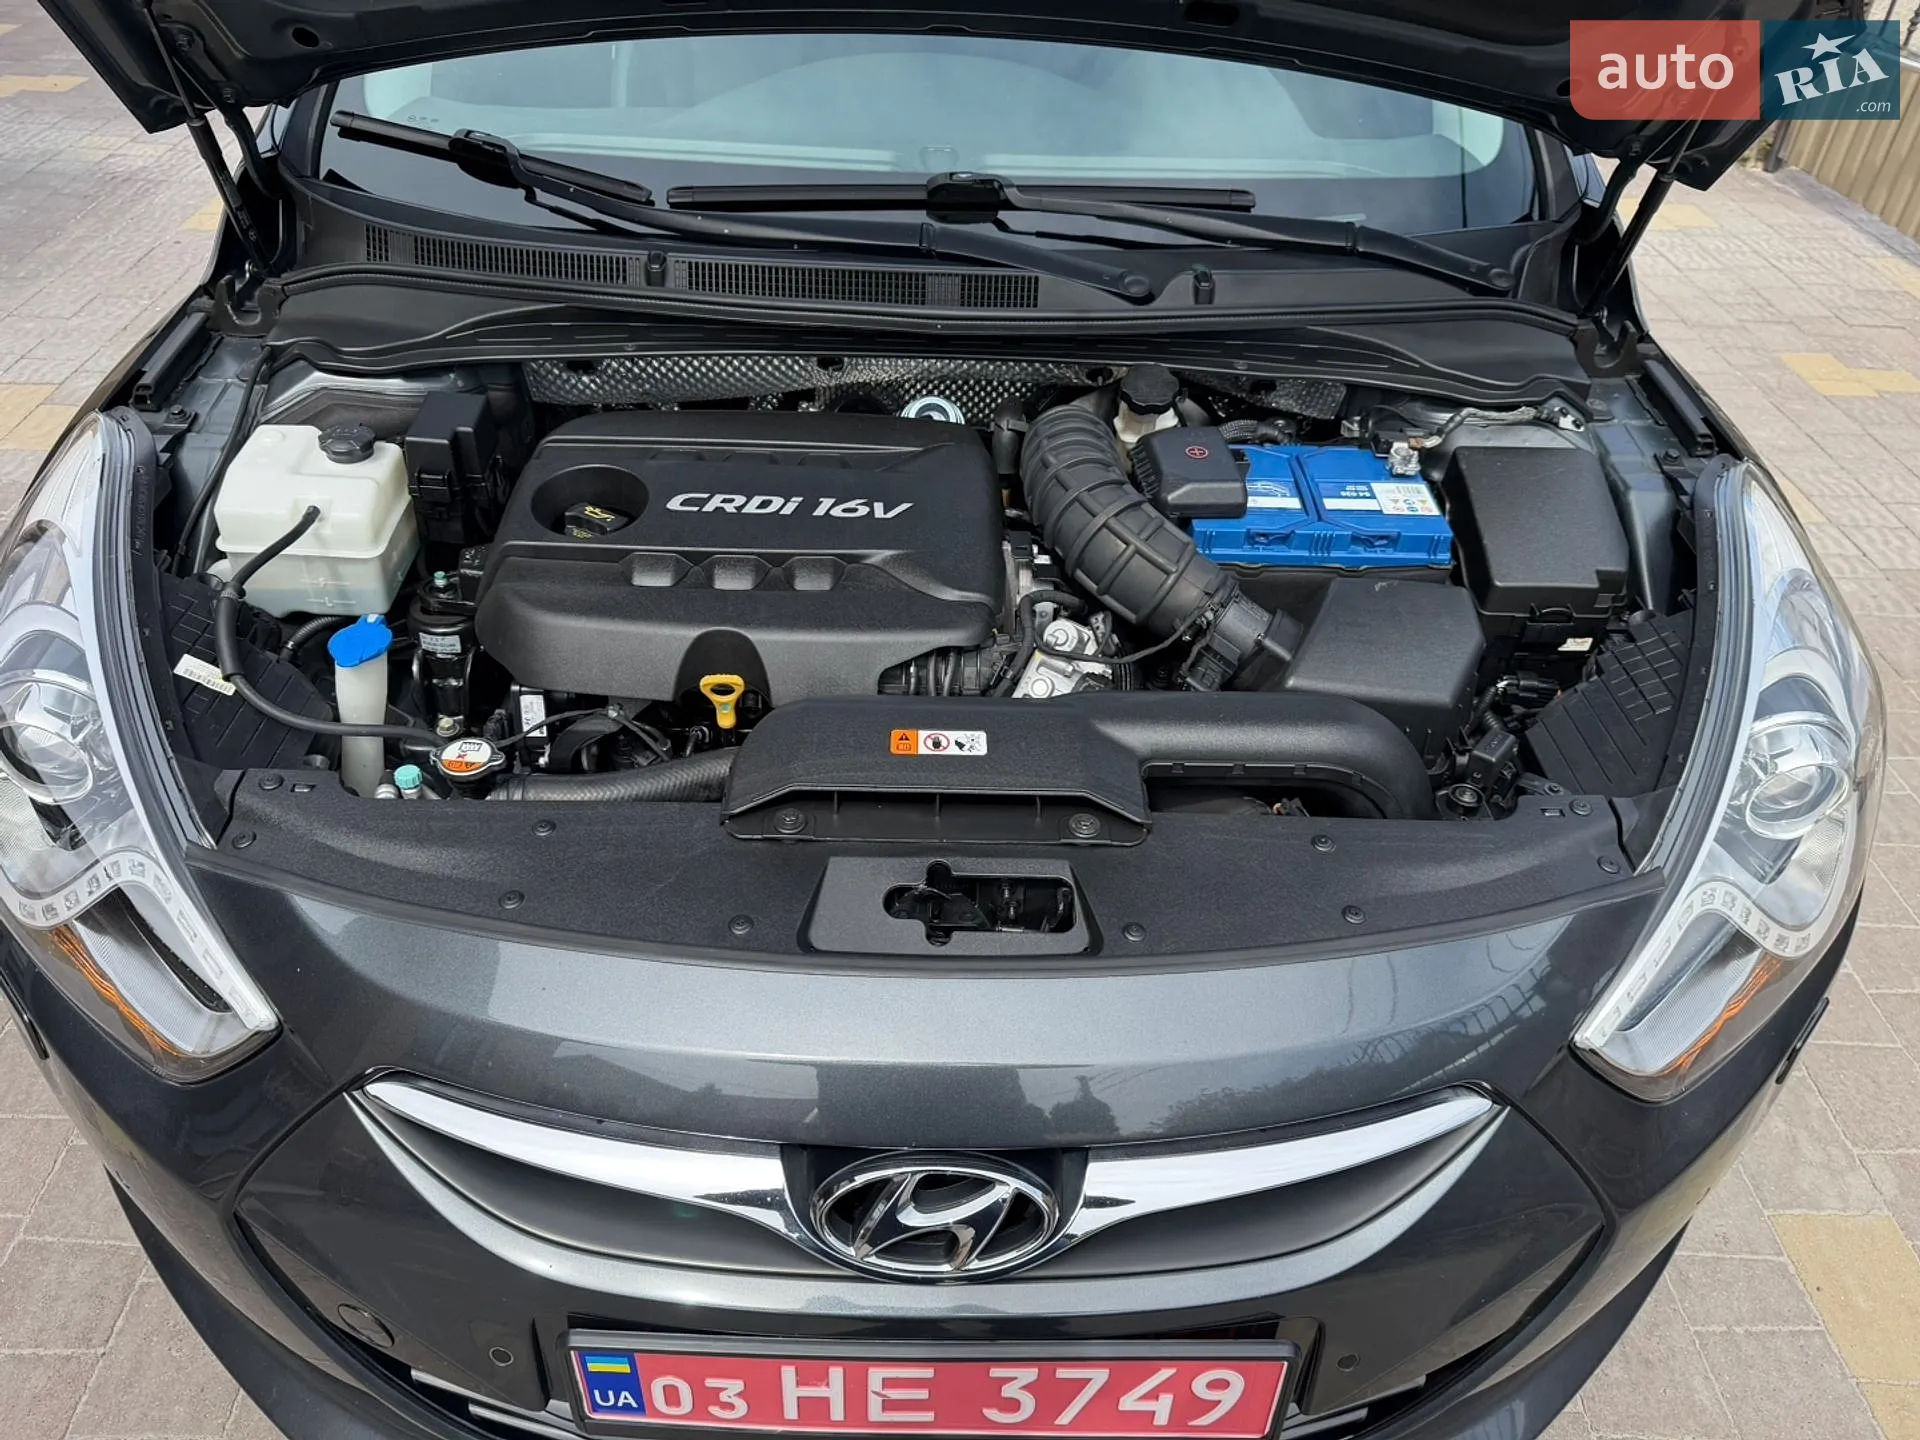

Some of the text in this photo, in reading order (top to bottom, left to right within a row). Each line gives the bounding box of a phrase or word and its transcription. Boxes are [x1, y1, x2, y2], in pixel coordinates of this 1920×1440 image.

[665, 492, 915, 519] CRDi 16V
[593, 1365, 1245, 1425] UA 03 HE 3749
